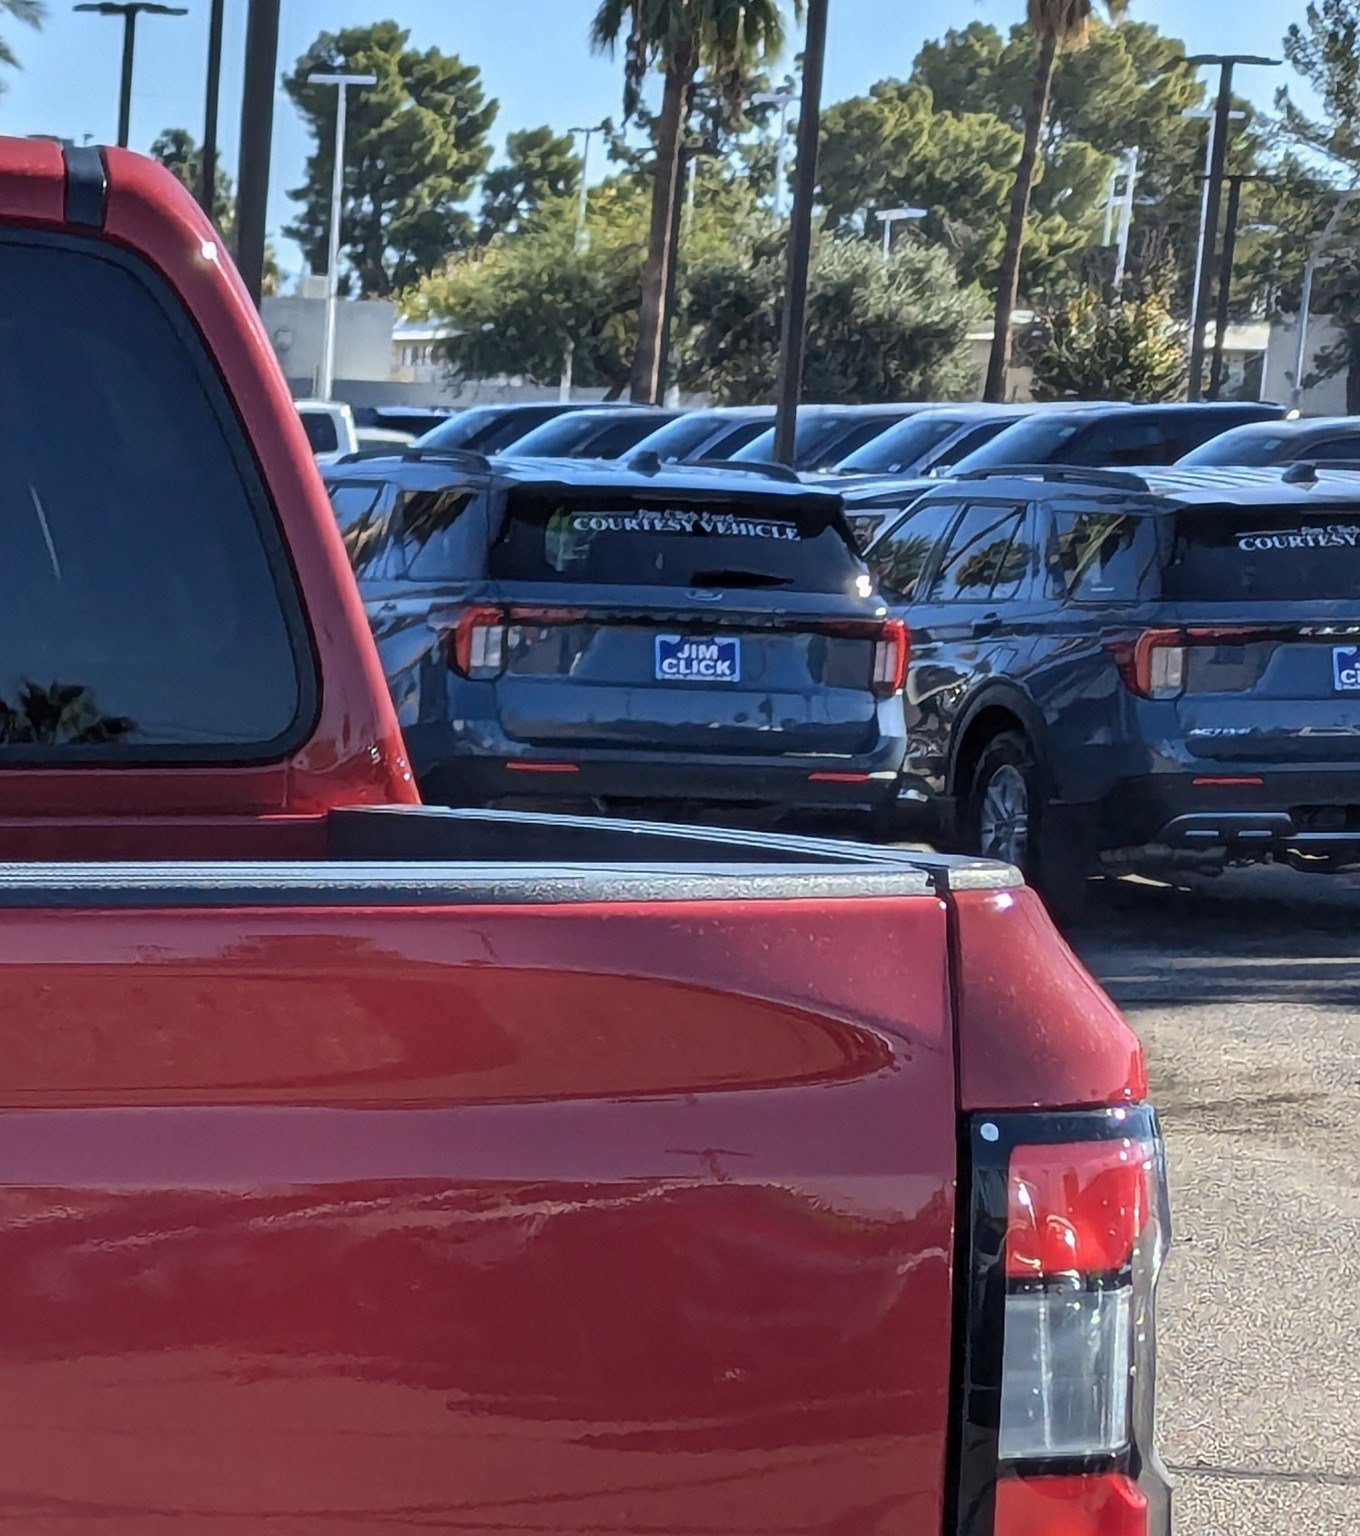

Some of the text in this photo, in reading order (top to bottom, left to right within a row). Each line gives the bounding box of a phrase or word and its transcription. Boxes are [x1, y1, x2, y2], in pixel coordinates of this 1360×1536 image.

[573, 516, 801, 541] COURTESY VEHICLE
[1238, 533, 1357, 551] COURTESY
[677, 643, 719, 660] JIM
[662, 658, 731, 675] CLICK
